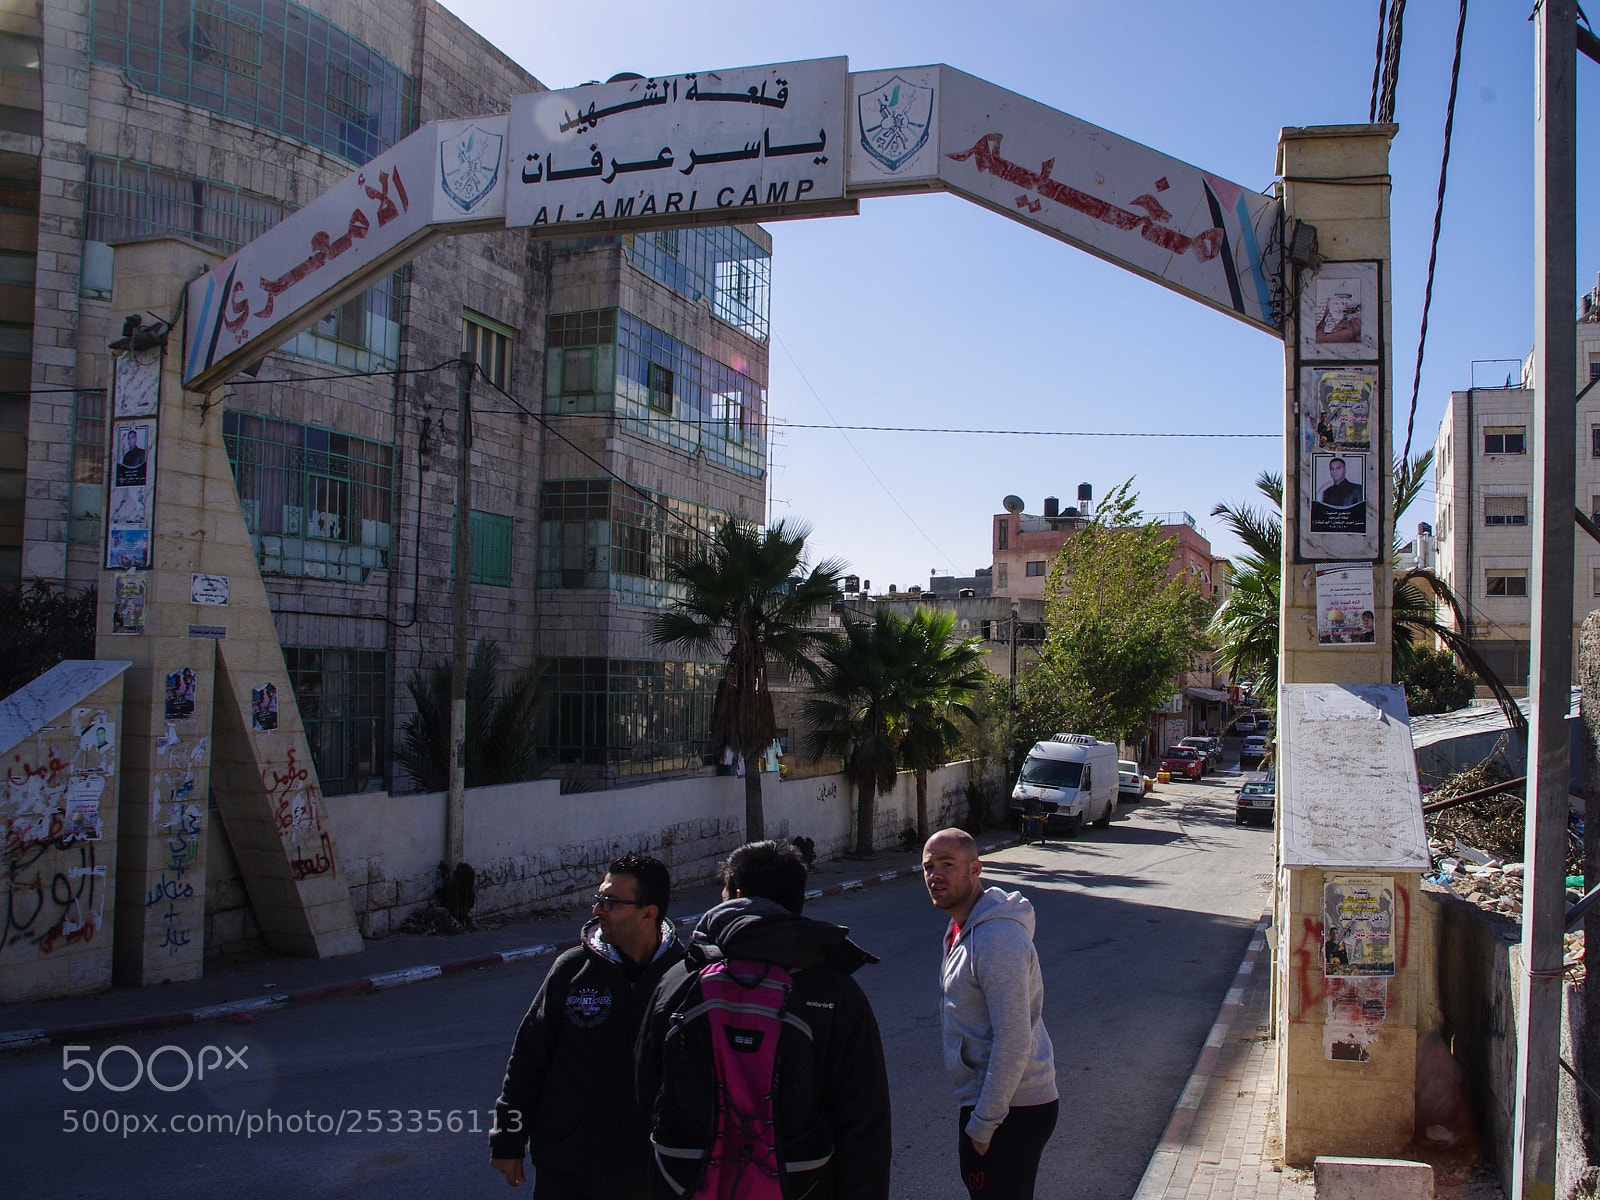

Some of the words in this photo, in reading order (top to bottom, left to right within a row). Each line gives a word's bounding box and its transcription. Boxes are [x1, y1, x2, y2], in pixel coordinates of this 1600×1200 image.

[559, 78, 678, 134] الشهيد
[685, 73, 788, 109] قلعة
[521, 143, 675, 184] عرفات
[678, 127, 829, 176] ياسر
[716, 179, 815, 208] CAMP
[944, 132, 1224, 264] مخيم
